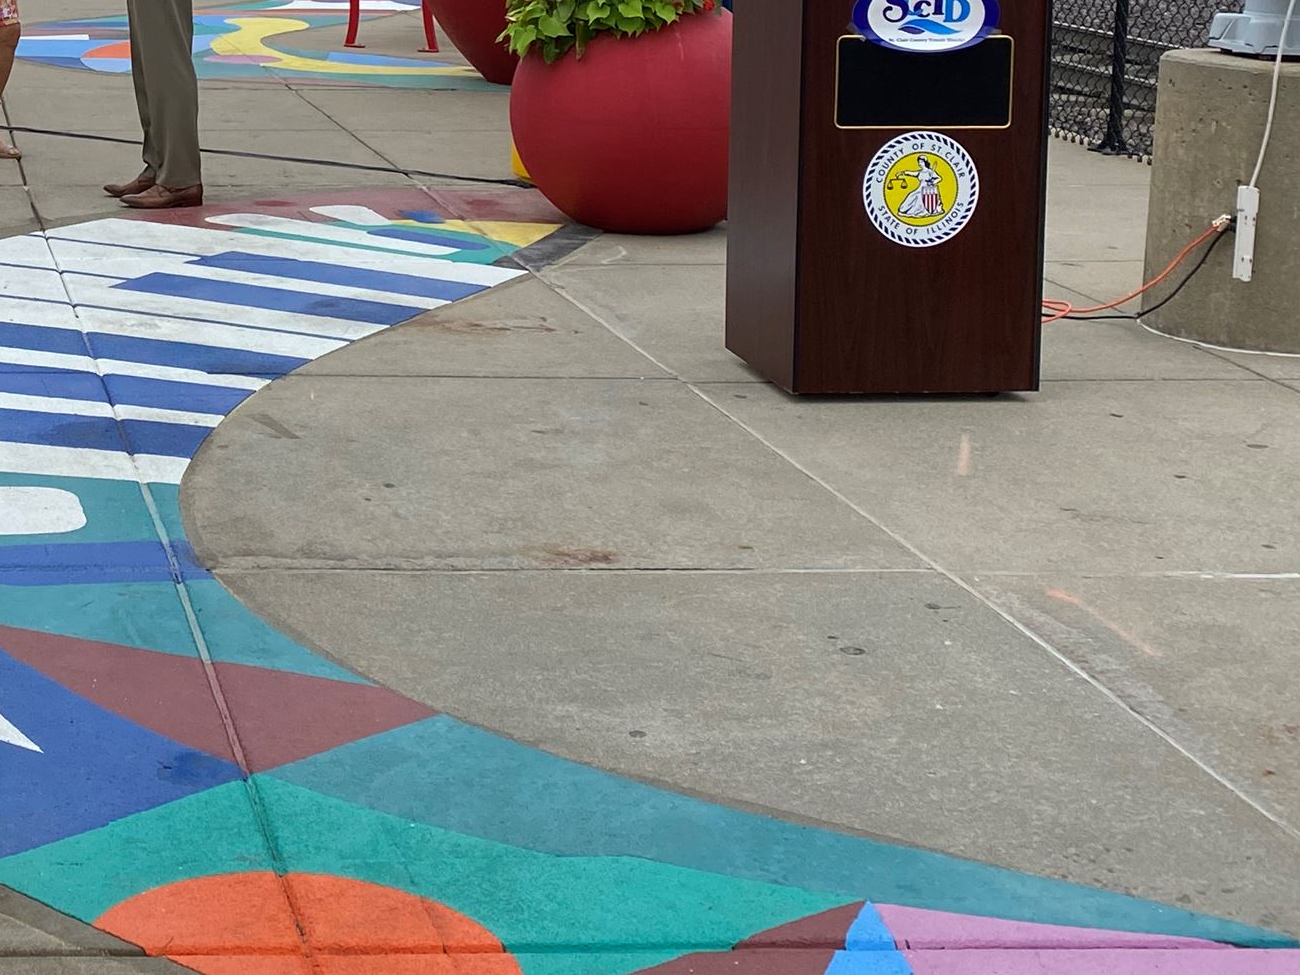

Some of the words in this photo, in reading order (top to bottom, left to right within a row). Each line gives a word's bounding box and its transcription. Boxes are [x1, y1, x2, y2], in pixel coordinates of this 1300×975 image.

[876, 148, 905, 183] COUNTY
[912, 142, 925, 151] OF
[945, 151, 966, 178] CLAIR
[878, 205, 900, 229] STATE
[905, 227, 918, 236] OF
[926, 201, 964, 235] ILLINOIS
